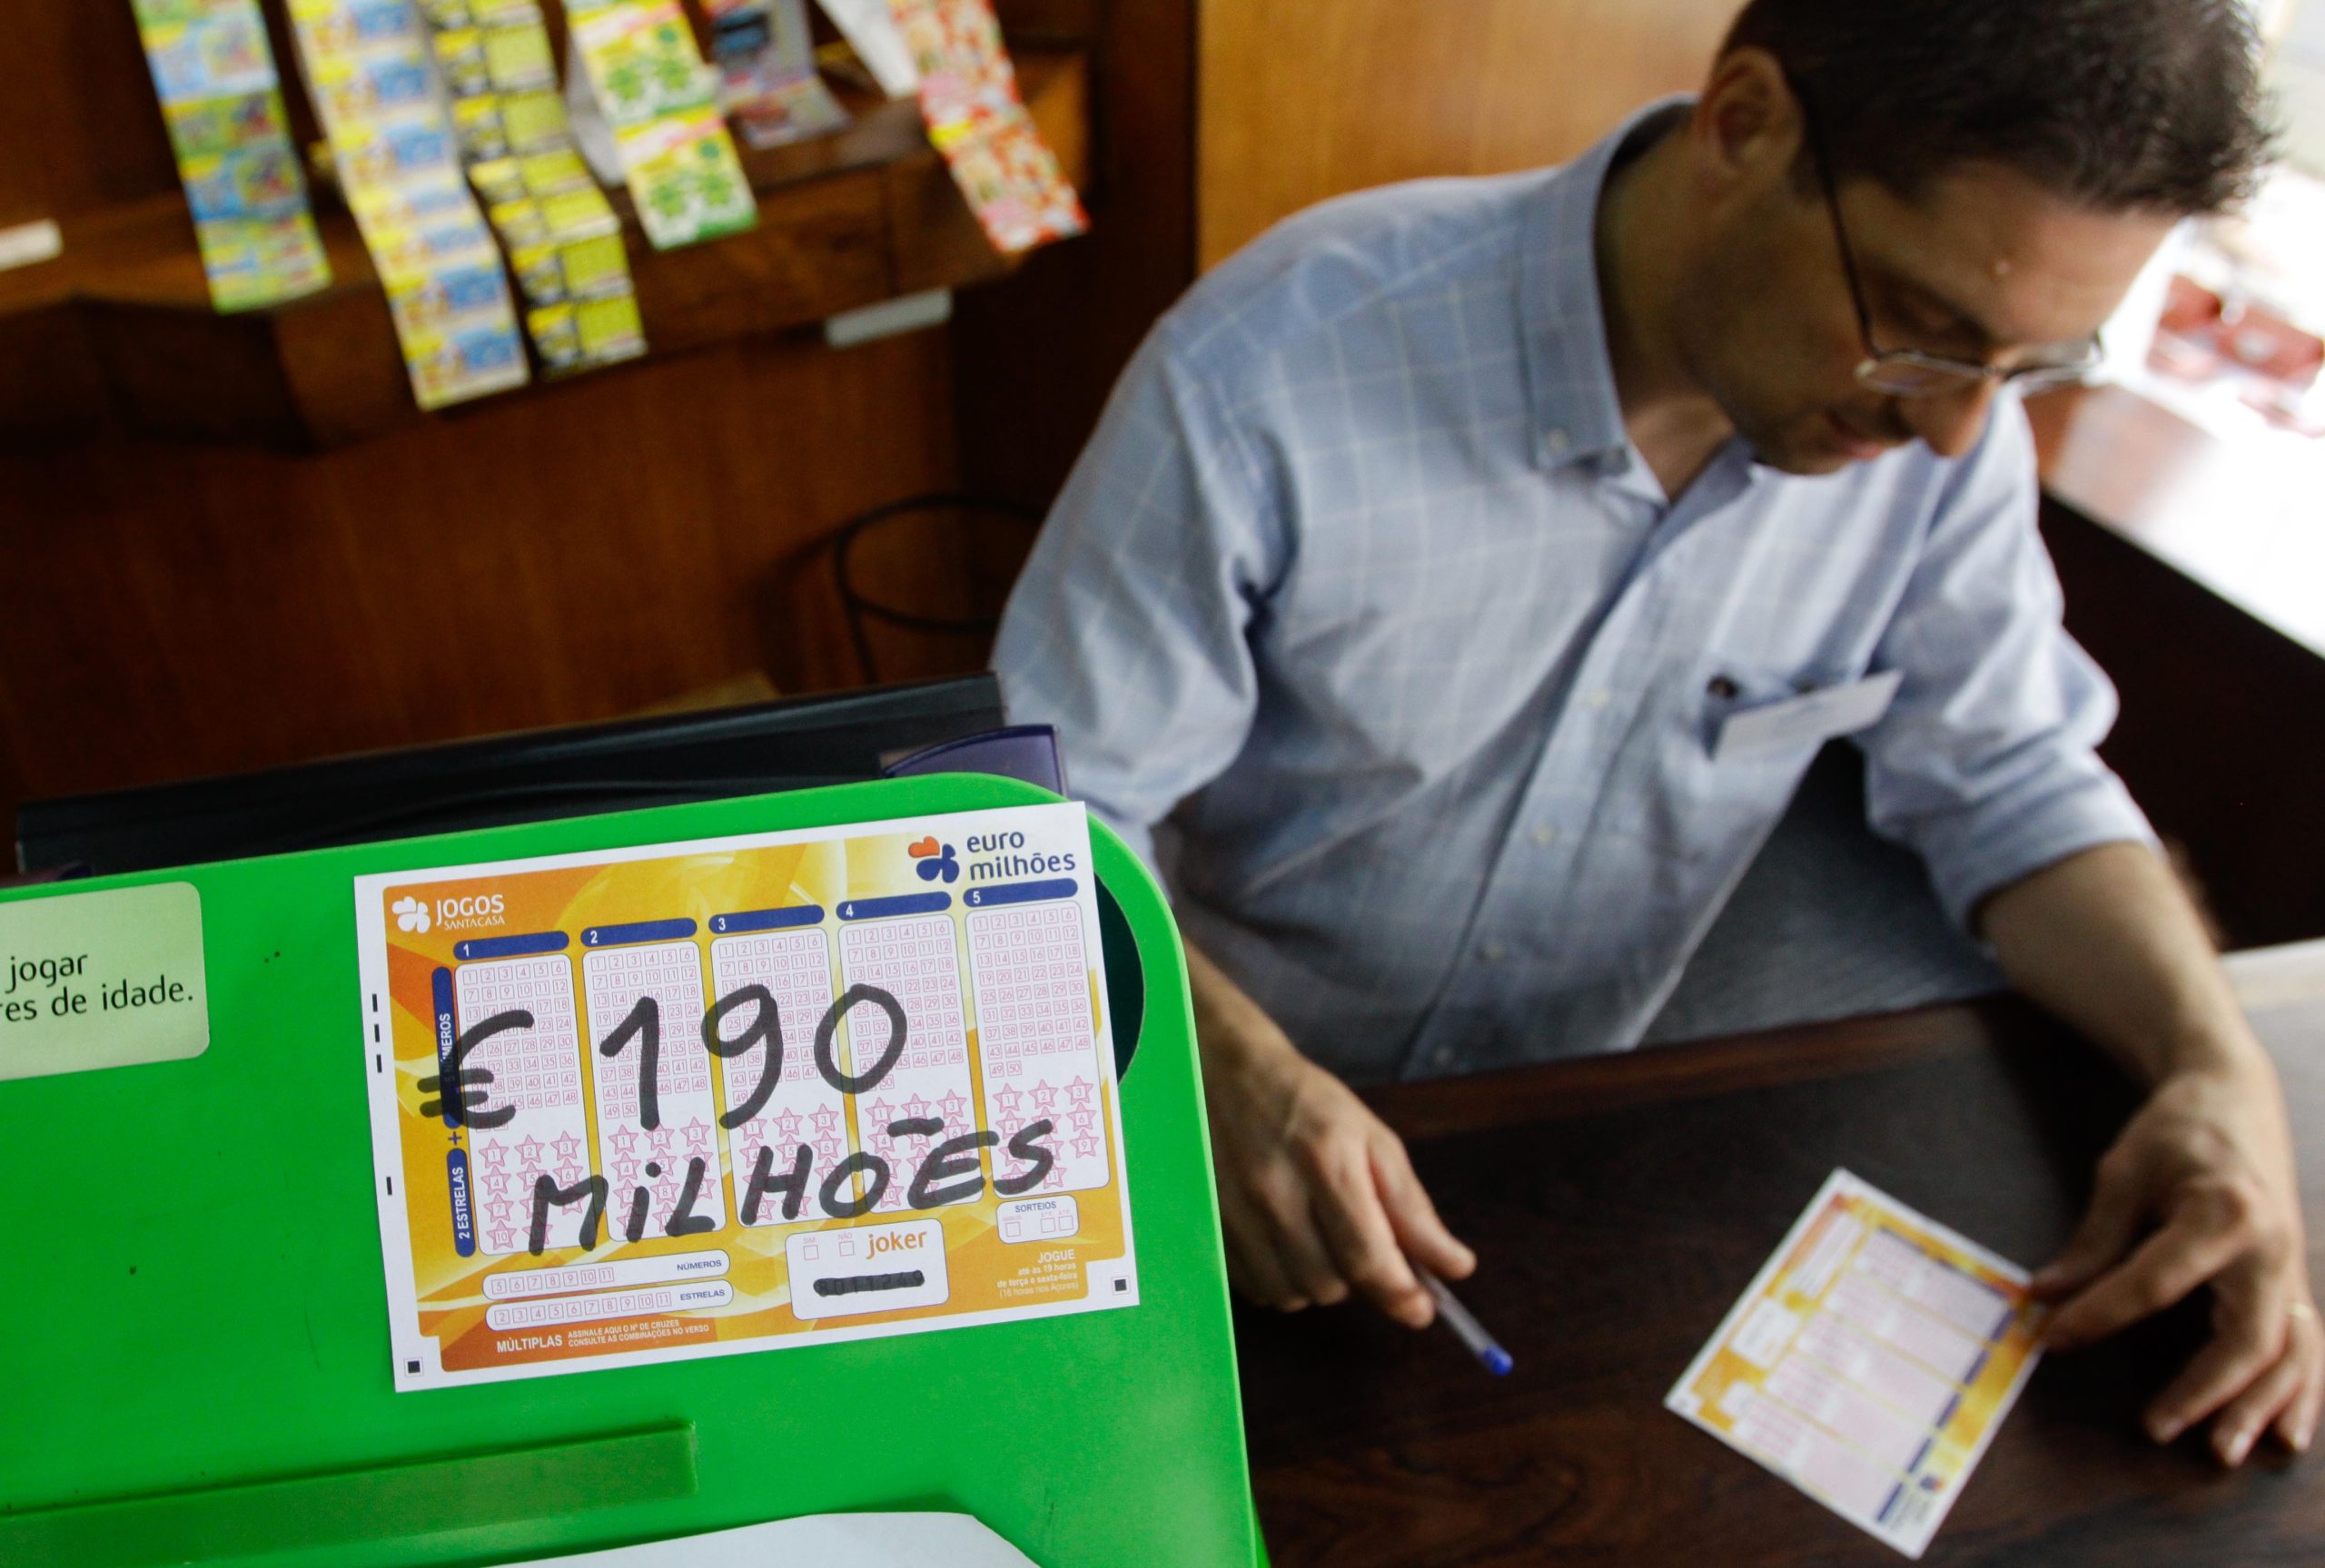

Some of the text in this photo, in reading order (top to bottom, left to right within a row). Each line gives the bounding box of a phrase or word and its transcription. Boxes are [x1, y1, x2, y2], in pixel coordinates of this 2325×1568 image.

[966, 831, 1025, 853] euro
[970, 852, 1076, 881] milhões
[973, 890, 981, 904] 5
[436, 894, 505, 926] JOGOS
[845, 904, 854, 917] 4
[444, 915, 506, 931] SANTACASA
[718, 918, 727, 931] 3
[590, 931, 598, 944] 2
[463, 943, 470, 957] 1
[776, 959, 787, 968] 10
[795, 957, 803, 966] 11
[813, 955, 824, 964] 12
[5, 954, 88, 994] jogar
[649, 972, 661, 982] 10
[667, 970, 676, 980] 11
[684, 968, 695, 978] 12
[519, 985, 530, 995] 10
[539, 983, 547, 993] 11
[555, 981, 566, 991] 12
[0, 974, 194, 1022] es de idade.
[599, 983, 908, 1130] 190
[452, 1166, 470, 1239] 2 ESTRELAS
[1015, 1201, 1057, 1213] SORTEIOS
[866, 1230, 927, 1259] joker
[1037, 1249, 1076, 1264] JOGUE
[583, 1272, 594, 1282] 10
[601, 1271, 611, 1281] 11
[677, 1259, 722, 1272] NÚMEROS
[641, 1297, 651, 1306] 10
[658, 1295, 668, 1305] 11
[680, 1289, 725, 1301] ESTRELAS
[568, 1328, 603, 1339] ASSINALE
[604, 1326, 622, 1335] AQUI
[640, 1322, 649, 1331] DE
[650, 1319, 680, 1329] CRUZES
[568, 1337, 606, 1348] CONSULTE
[607, 1335, 618, 1344] AS
[673, 1327, 683, 1336] NO
[684, 1324, 709, 1334] VERSO
[497, 1335, 563, 1353] MÚLTIPLAS
